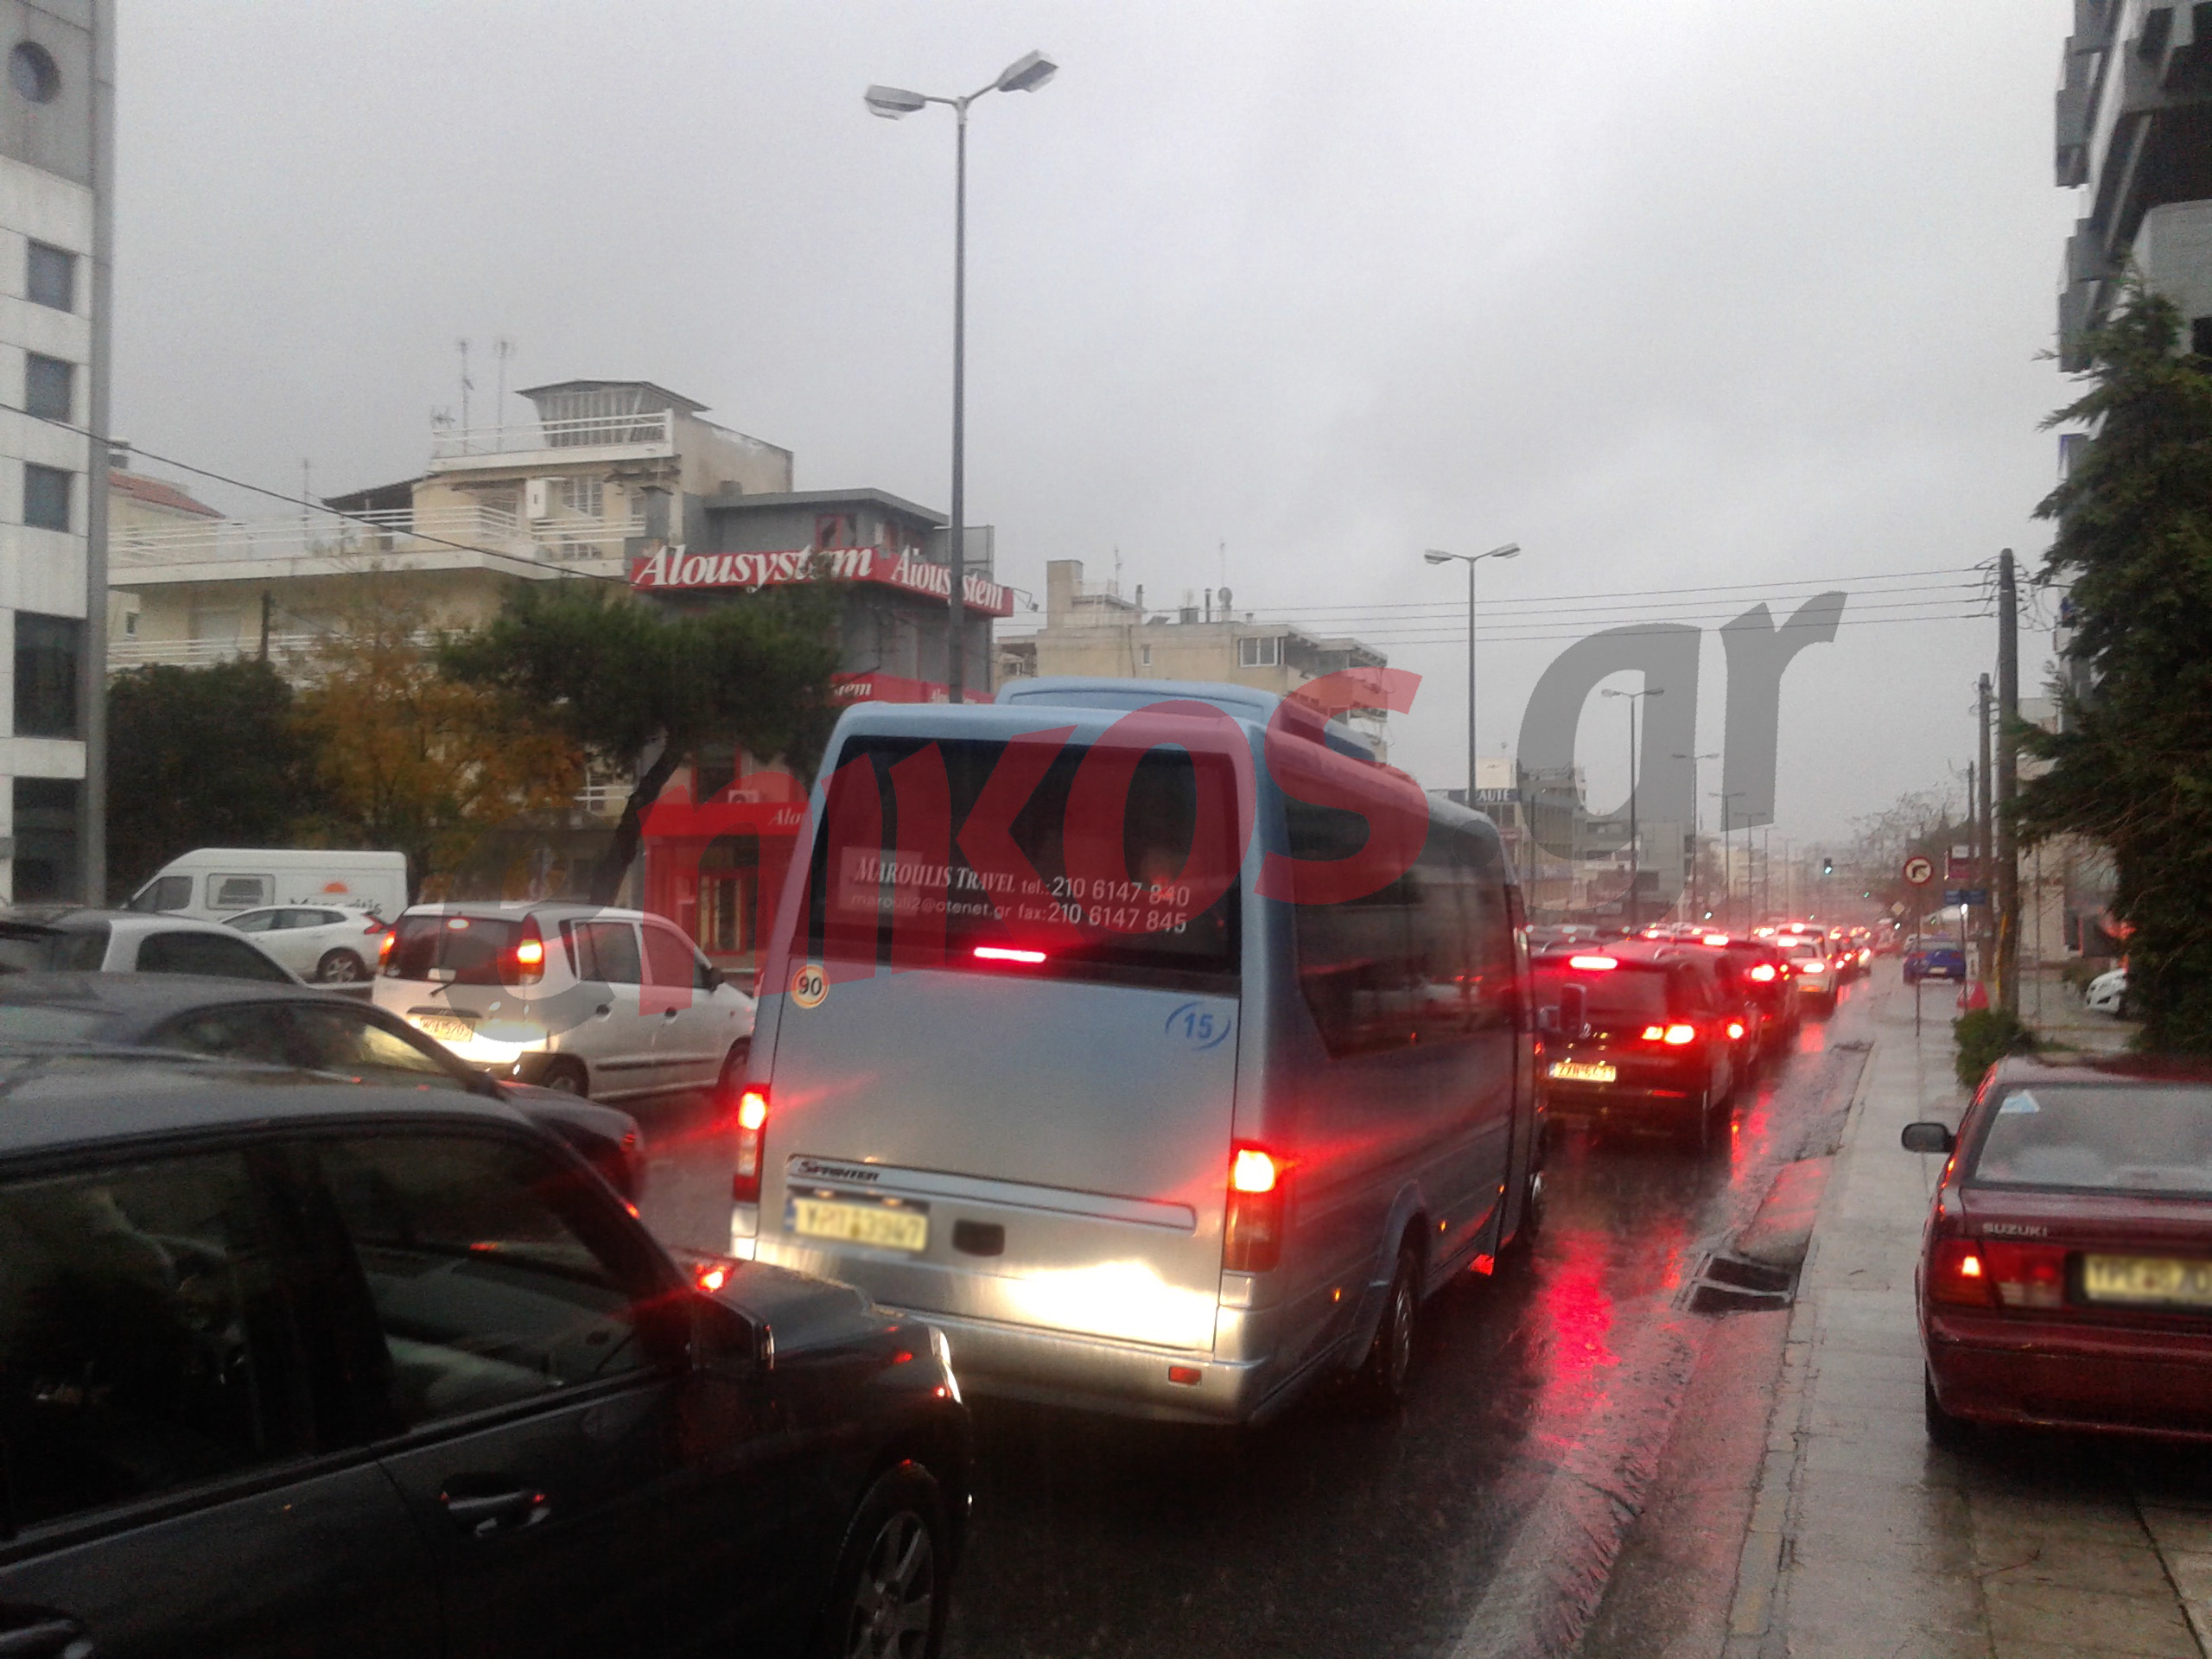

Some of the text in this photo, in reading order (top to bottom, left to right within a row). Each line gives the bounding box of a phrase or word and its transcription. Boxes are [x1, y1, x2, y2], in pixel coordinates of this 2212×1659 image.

[634, 543, 873, 594] Alousystm
[890, 545, 1004, 610] Alousstem
[854, 856, 952, 887] MAROULIS
[957, 867, 1016, 893] TRAVEL
[1092, 879, 1142, 903] 6147
[1149, 884, 1190, 907] 840
[1088, 906, 1141, 929] 6147
[1146, 910, 1187, 934] 845
[797, 976, 823, 996] 90
[1184, 1013, 1213, 1039] 15
[797, 1160, 880, 1183] SPRINTER
[1982, 1222, 2048, 1237] SUZUKI
